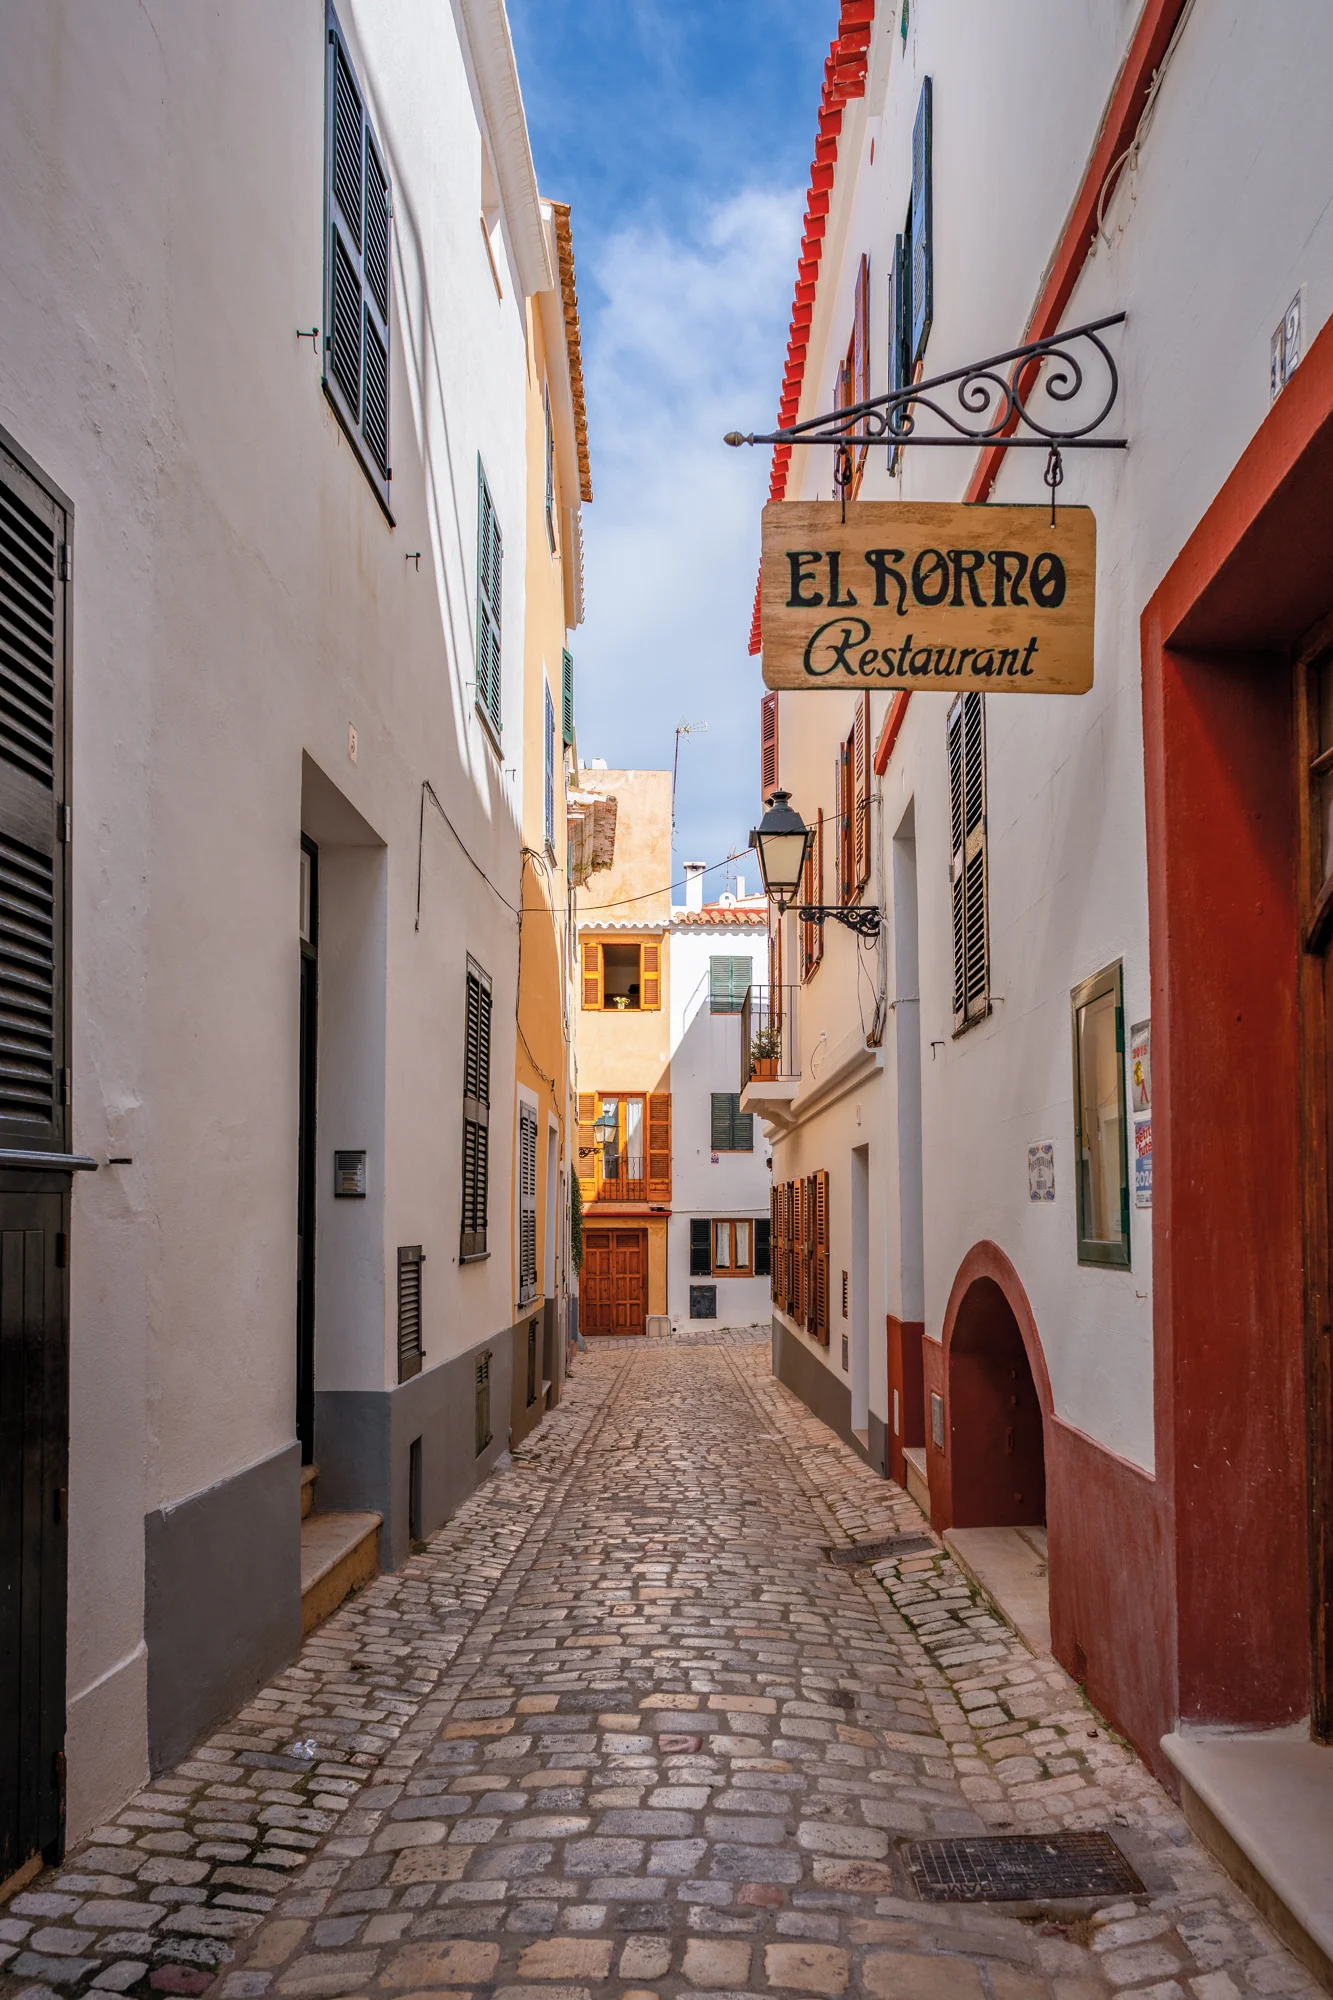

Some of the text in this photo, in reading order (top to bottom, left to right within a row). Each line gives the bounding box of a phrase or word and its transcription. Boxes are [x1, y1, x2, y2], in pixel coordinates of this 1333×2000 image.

[1272, 298, 1299, 397] 12
[785, 548, 1067, 616] EL HORNO
[803, 616, 1039, 678] Restaurant
[1132, 1043, 1148, 1059] 2015
